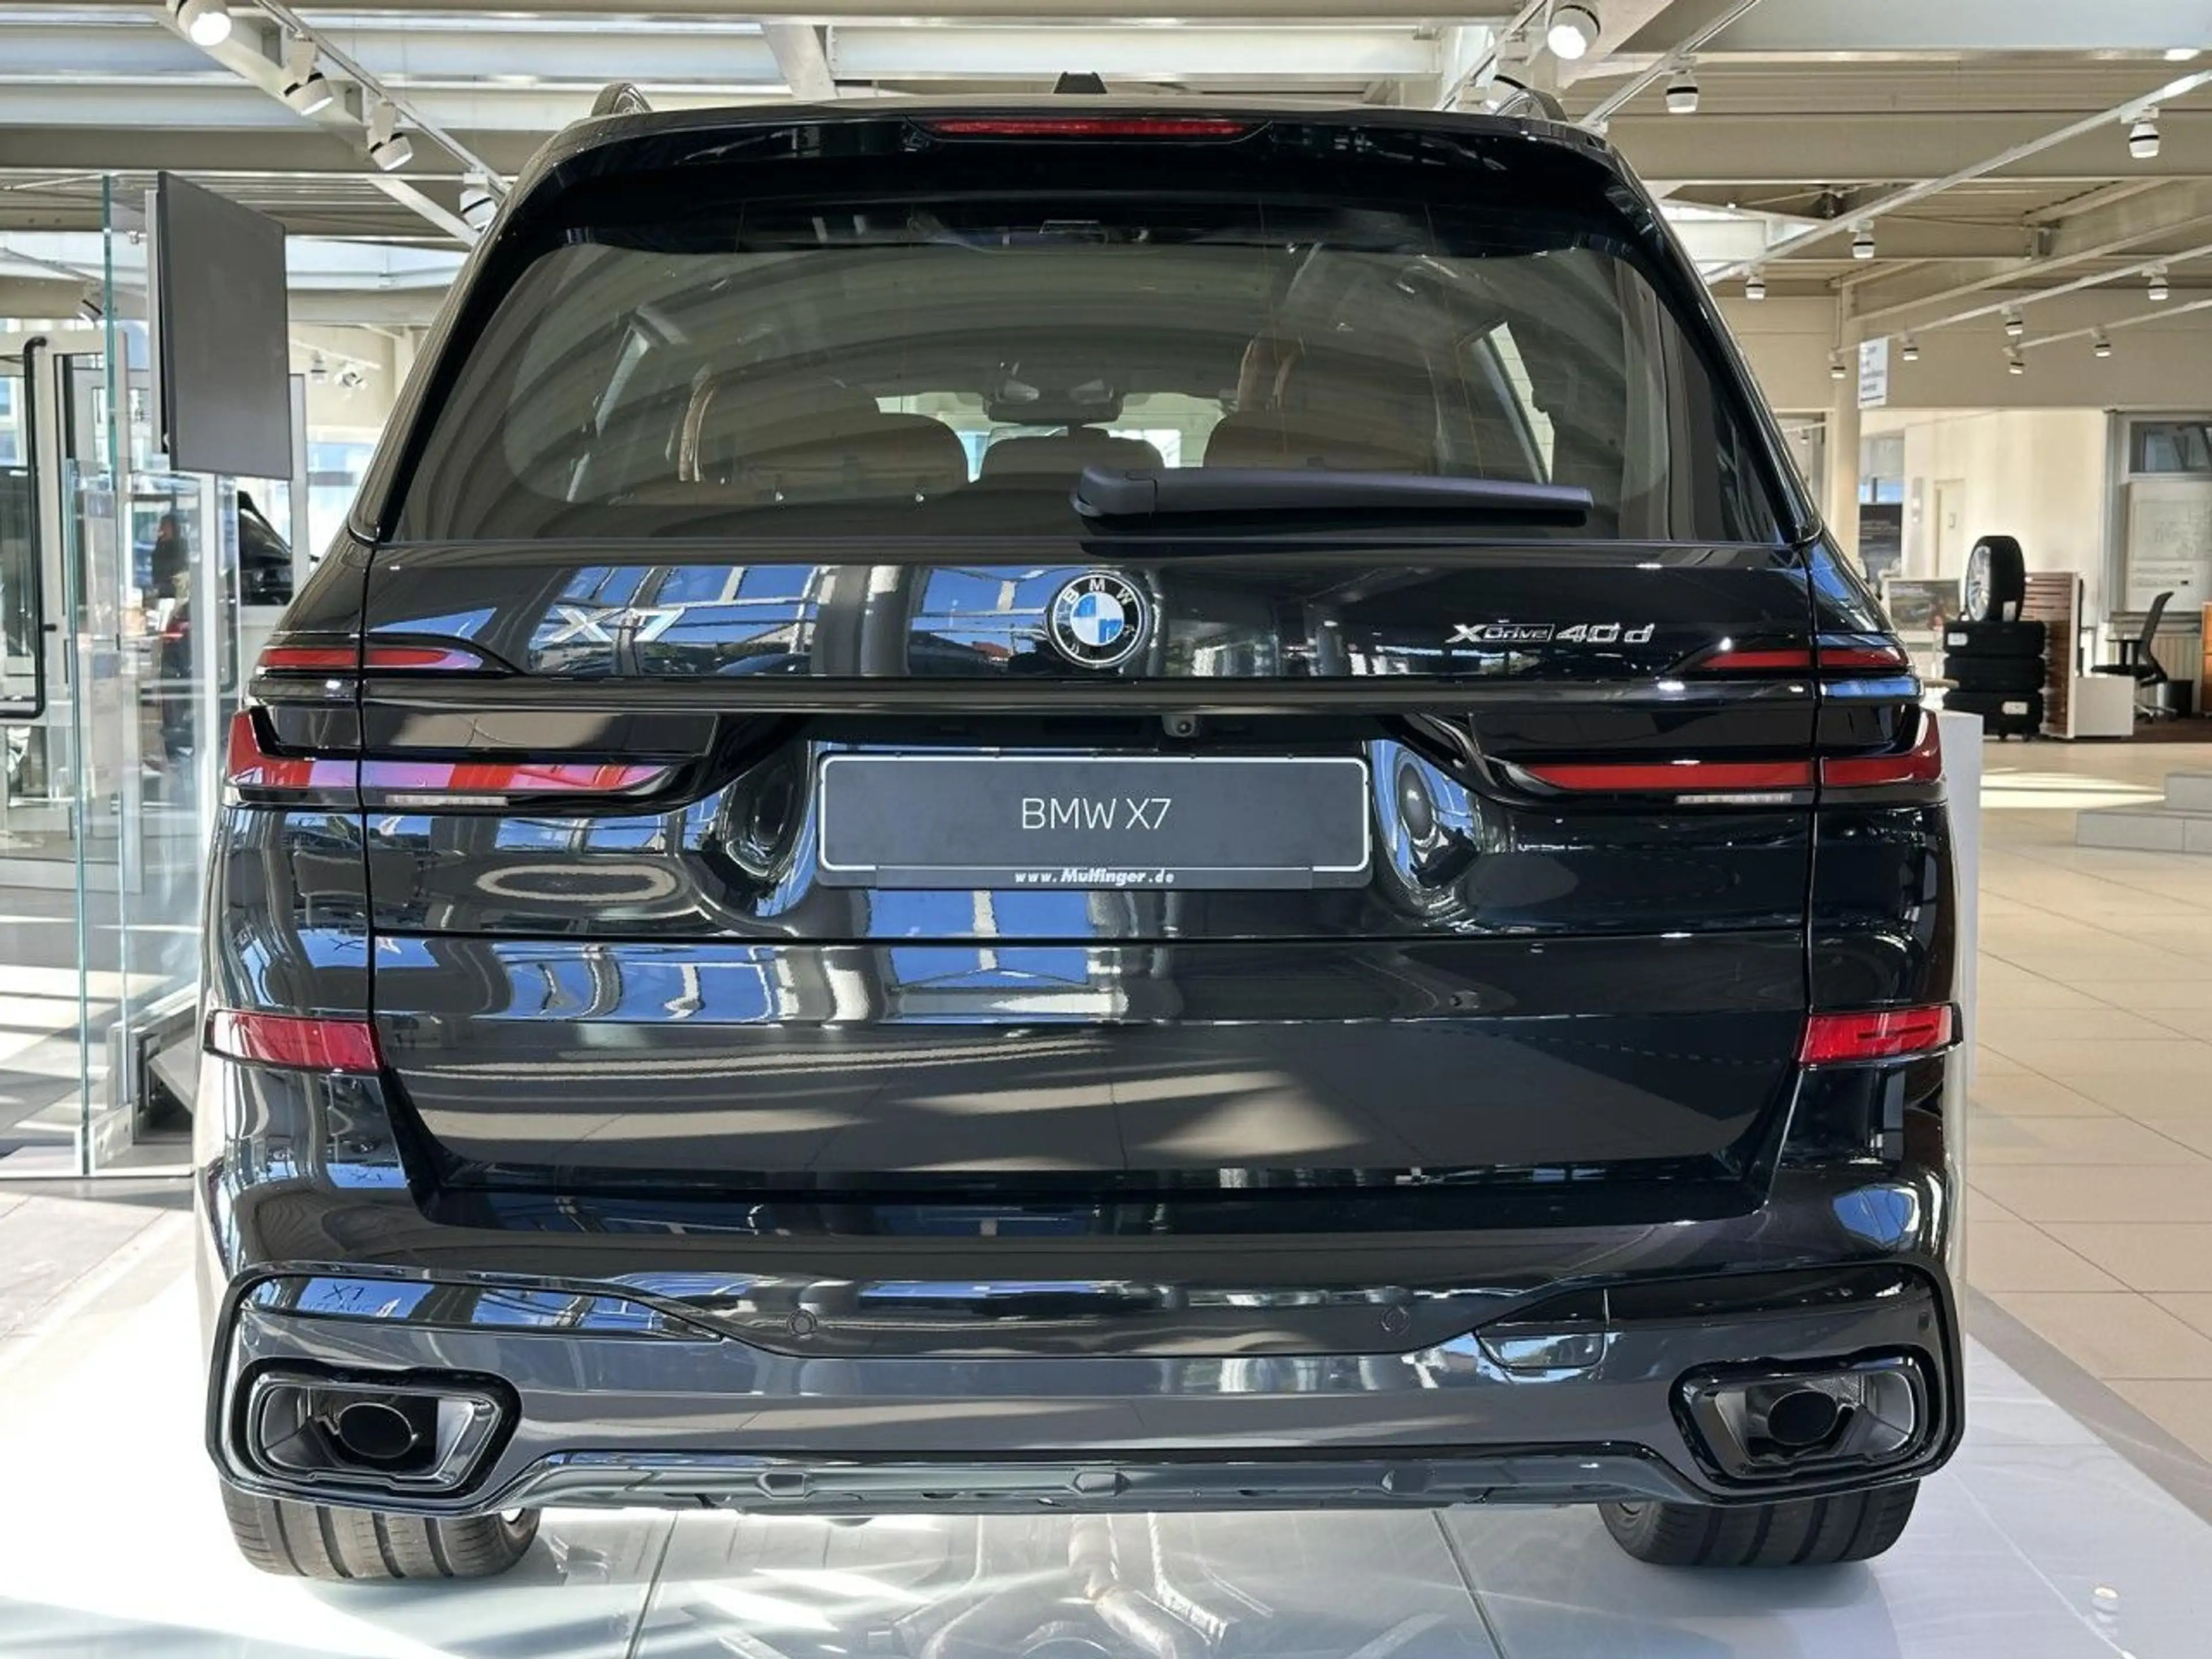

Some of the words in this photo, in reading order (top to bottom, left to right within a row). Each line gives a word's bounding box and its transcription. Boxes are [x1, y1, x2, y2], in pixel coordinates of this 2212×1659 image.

[1063, 578, 1134, 605] BMW
[538, 608, 685, 642] X7
[1022, 798, 1116, 829] BMW
[1125, 798, 1171, 829] X7
[1014, 867, 1175, 886] www.Mulfinger.de
